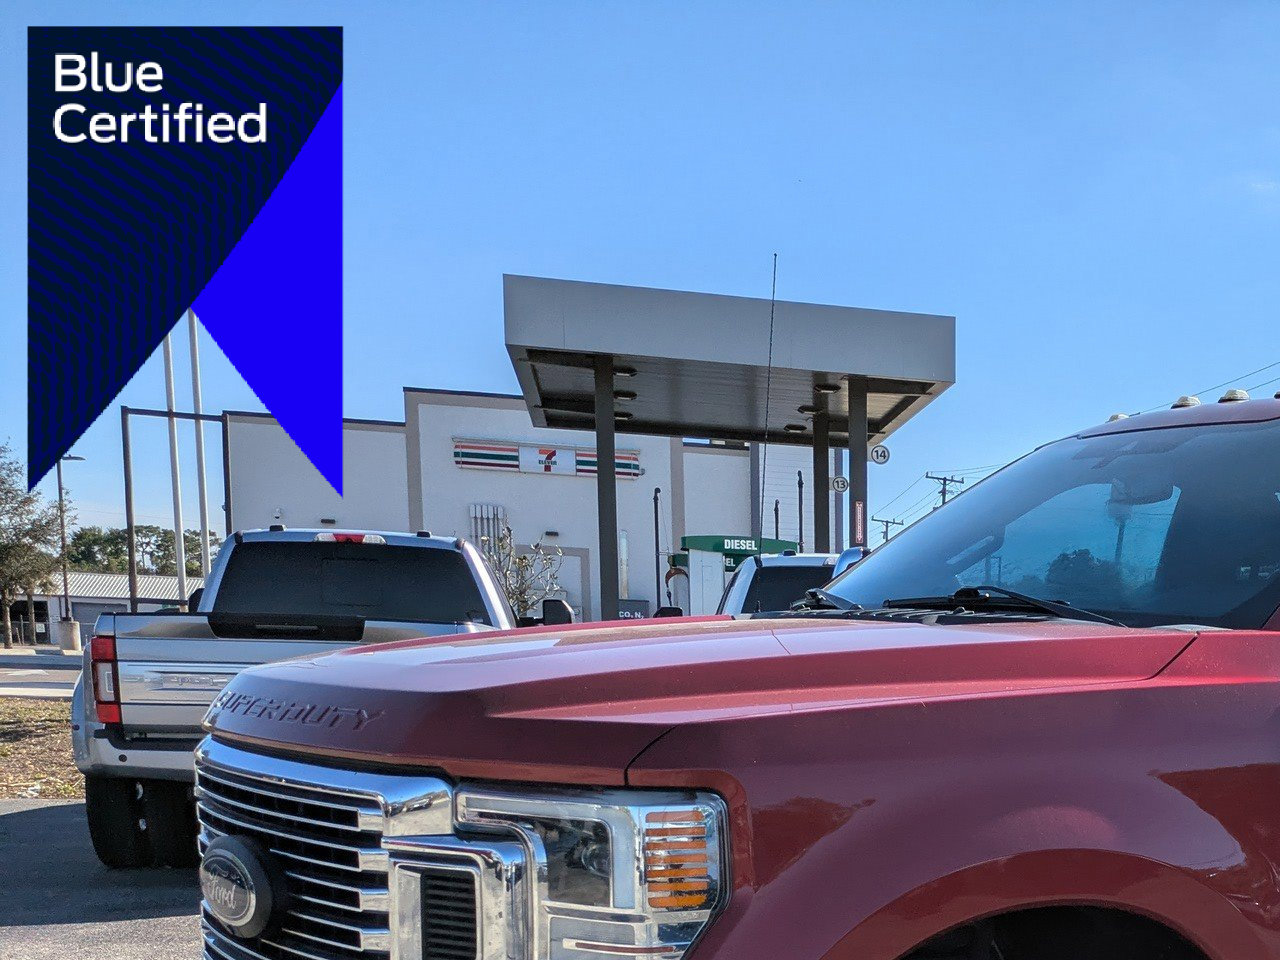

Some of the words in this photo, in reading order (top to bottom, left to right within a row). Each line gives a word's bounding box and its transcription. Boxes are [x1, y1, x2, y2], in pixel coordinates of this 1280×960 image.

[539, 448, 557, 472] 7
[874, 449, 887, 460] 14
[835, 480, 846, 489] 13
[724, 538, 758, 551] DIESEL
[277, 701, 387, 731] DUTY
